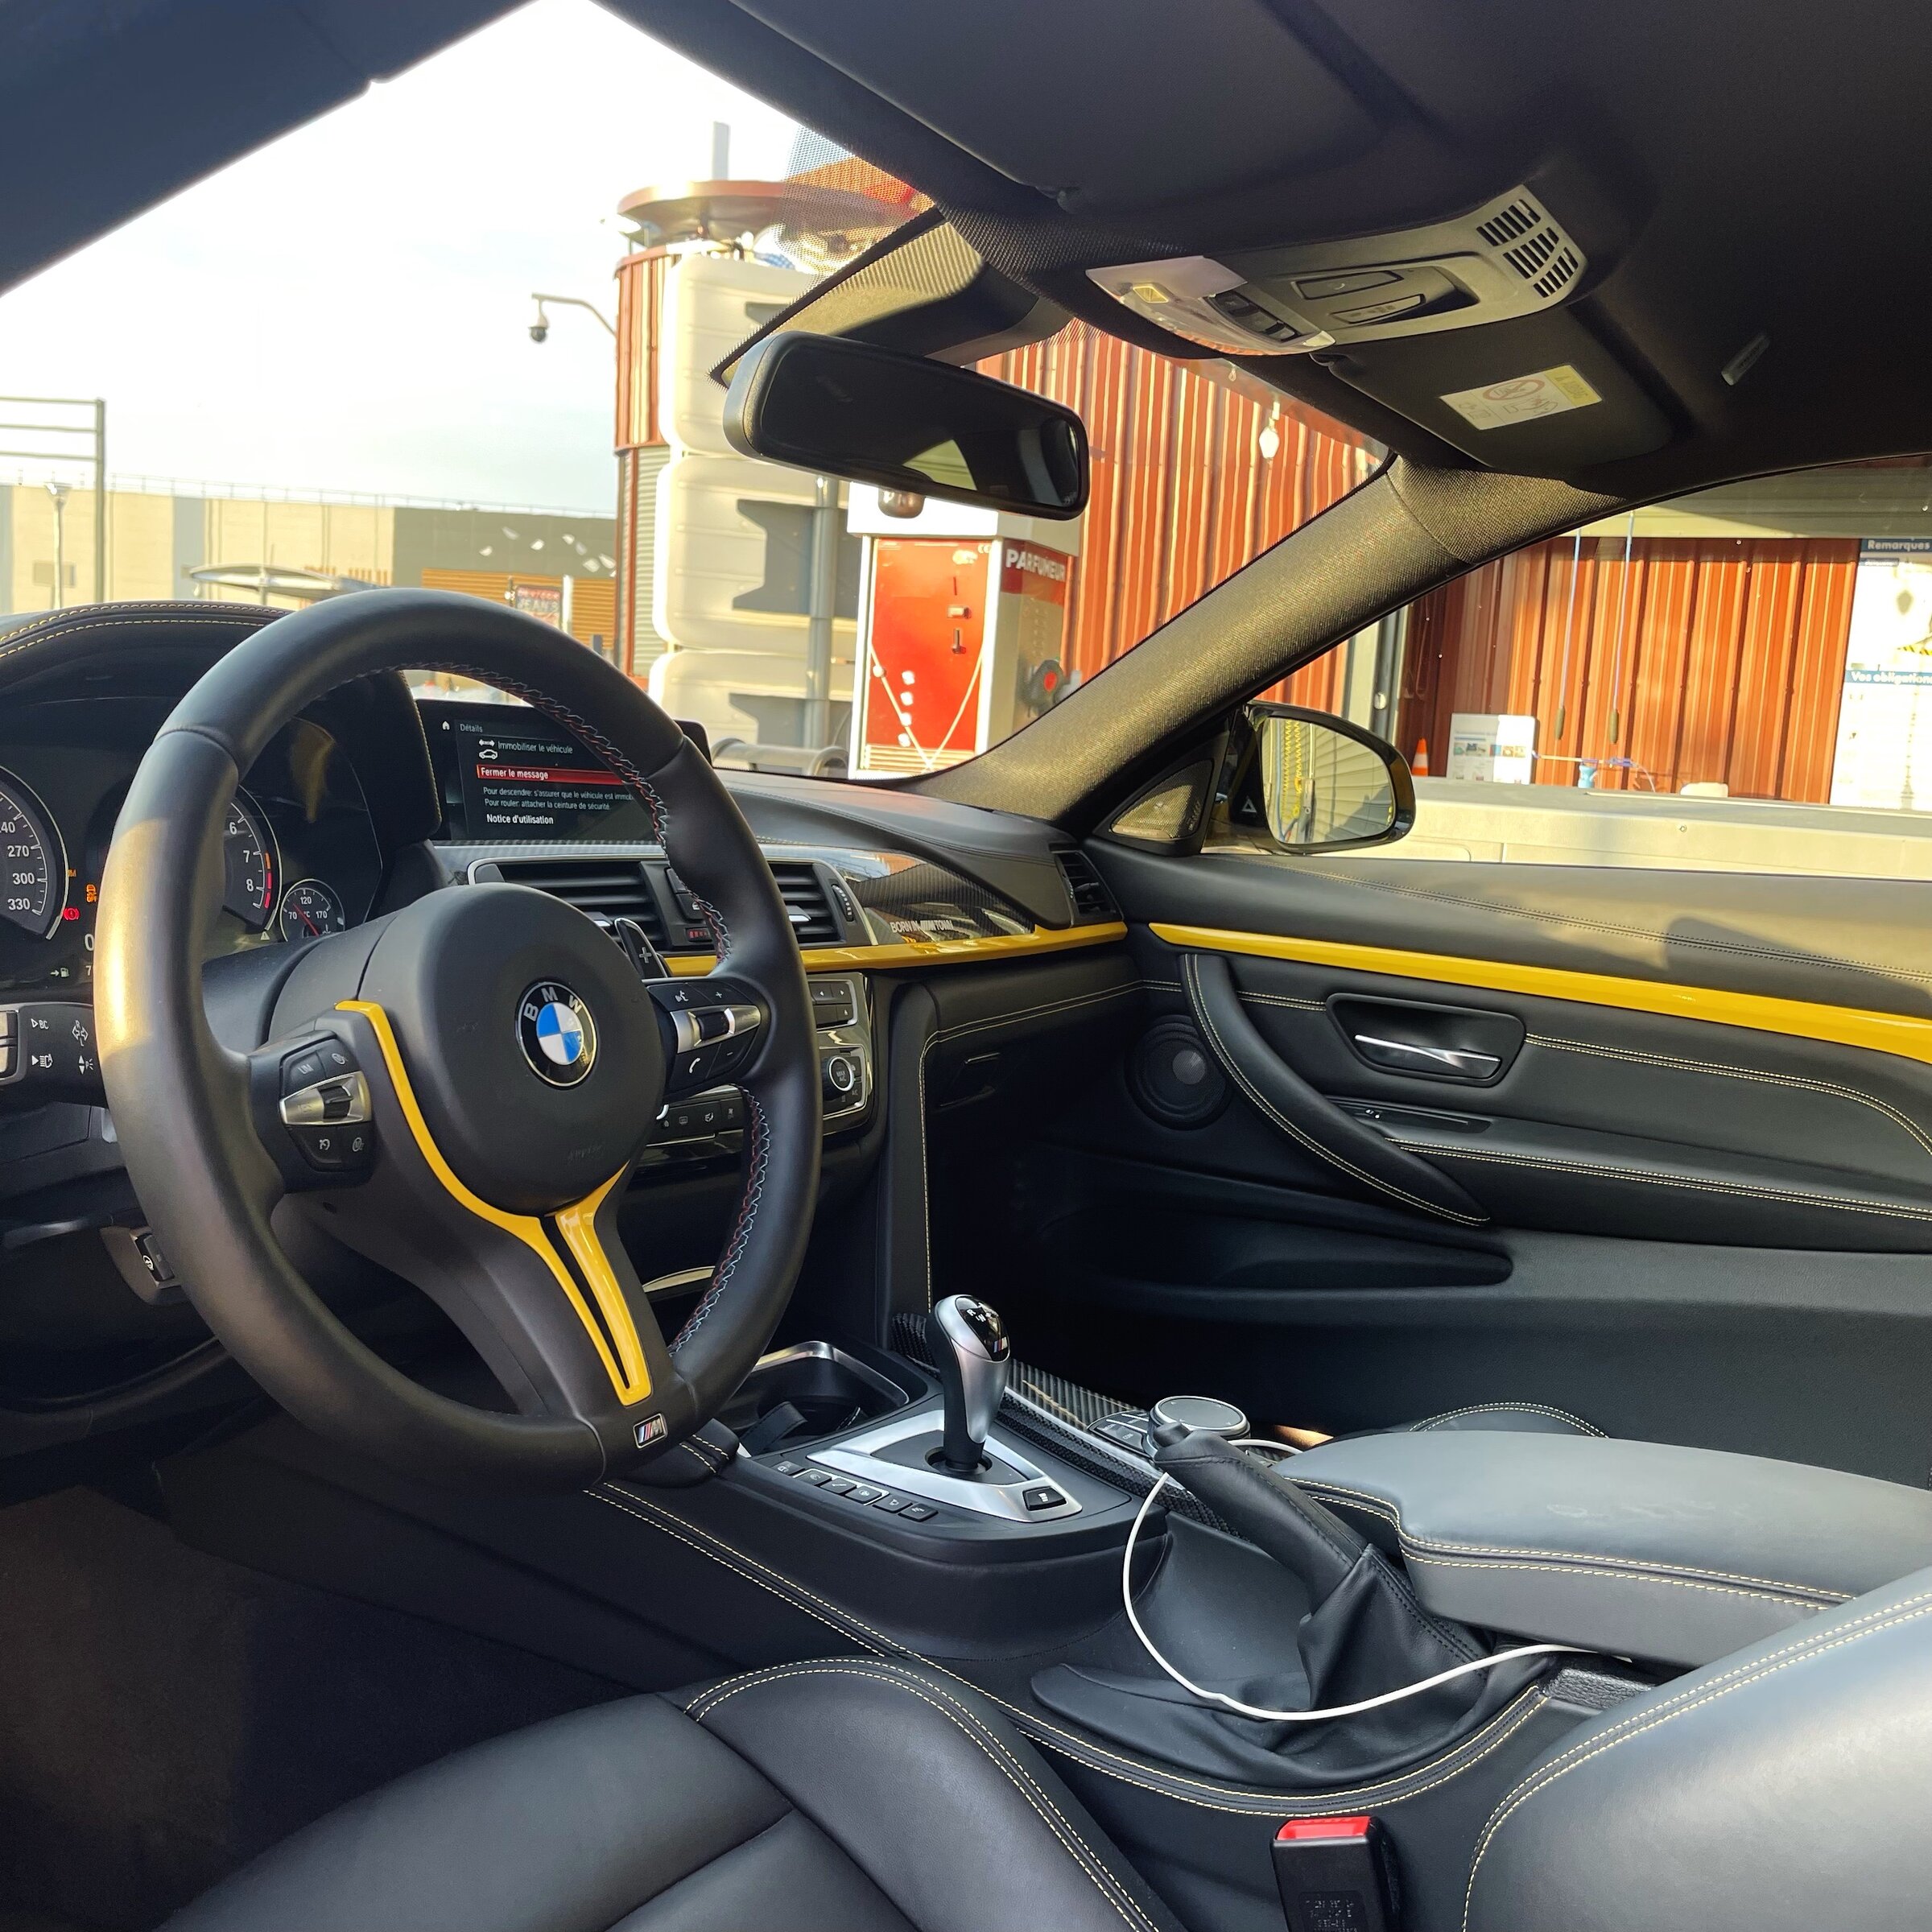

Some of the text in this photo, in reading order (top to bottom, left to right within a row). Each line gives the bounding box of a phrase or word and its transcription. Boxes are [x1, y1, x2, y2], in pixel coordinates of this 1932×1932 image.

[1867, 539, 1930, 552] Remarques
[1005, 547, 1067, 583] PARFUMEUR
[1851, 670, 1872, 683] Vos
[460, 723, 483, 733] Détails
[497, 741, 573, 755] Immobiliser le véhicule
[481, 767, 549, 782] Fermer le message
[483, 786, 498, 795] Pour
[561, 791, 573, 799] que
[573, 791, 580, 799] le
[580, 791, 603, 800] véhicule
[485, 798, 500, 807] Pour
[521, 800, 546, 809] attacher
[547, 800, 553, 809] la
[554, 801, 578, 810] ceinture
[578, 802, 587, 810] de
[486, 813, 554, 825] Notice d'utilisation
[0, 821, 16, 834] 40
[229, 822, 237, 835] 6
[7, 845, 30, 857] 270
[243, 849, 250, 863] 7
[12, 873, 35, 885] 300
[246, 878, 254, 892] 8
[7, 898, 31, 911] 330
[300, 896, 312, 905] 120
[288, 911, 298, 920] 70
[316, 910, 328, 919] 170
[523, 986, 582, 1022] BMW
[39, 1019, 49, 1030] BC
[298, 1063, 314, 1075] LIM
[966, 1308, 976, 1317] R
